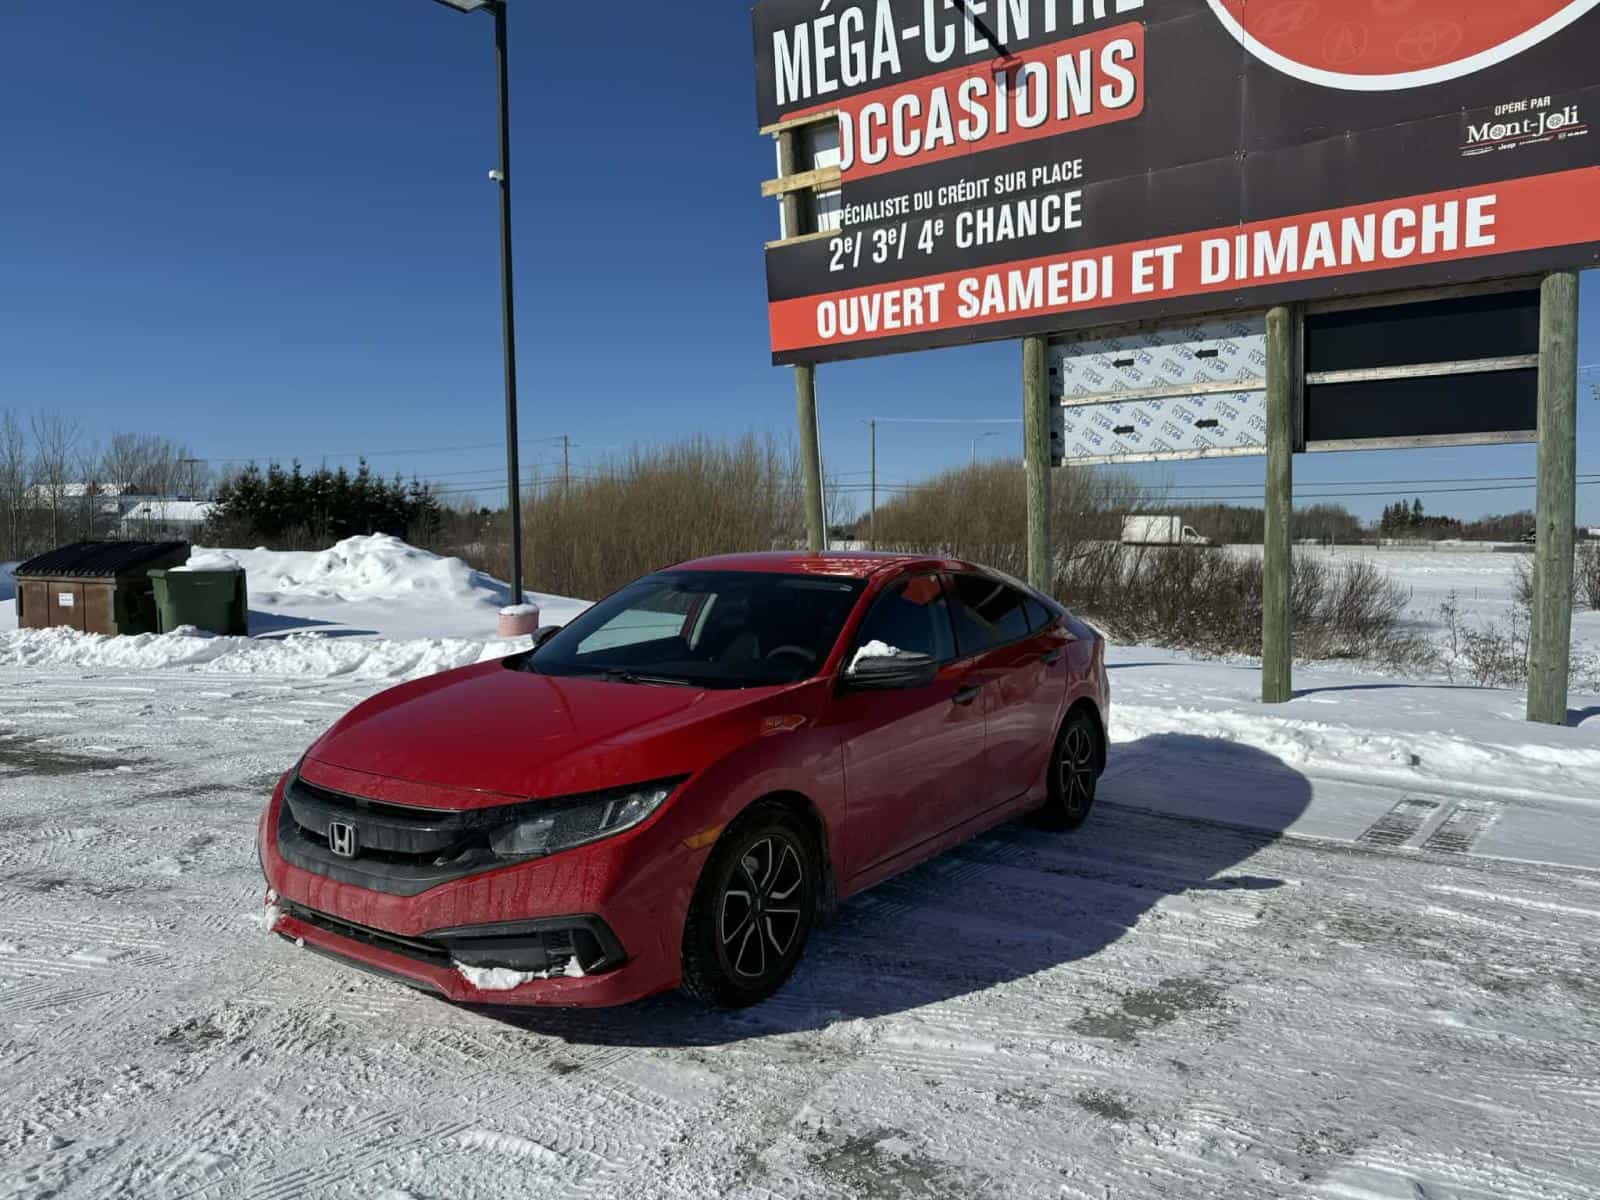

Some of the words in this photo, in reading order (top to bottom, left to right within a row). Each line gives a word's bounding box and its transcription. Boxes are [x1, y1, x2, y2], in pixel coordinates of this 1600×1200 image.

[1465, 105, 1580, 143] Mont-Joli
[914, 190, 933, 211] DU
[938, 177, 989, 206] CRÉDIT
[994, 170, 1026, 193] SUR
[1032, 159, 1083, 185] PLACE
[956, 190, 1083, 249] CHANCE
[816, 282, 946, 339] OUVERT
[957, 255, 1113, 319] SAMEDI
[1131, 244, 1183, 294] ET
[1200, 194, 1497, 286] DIMANCHE
